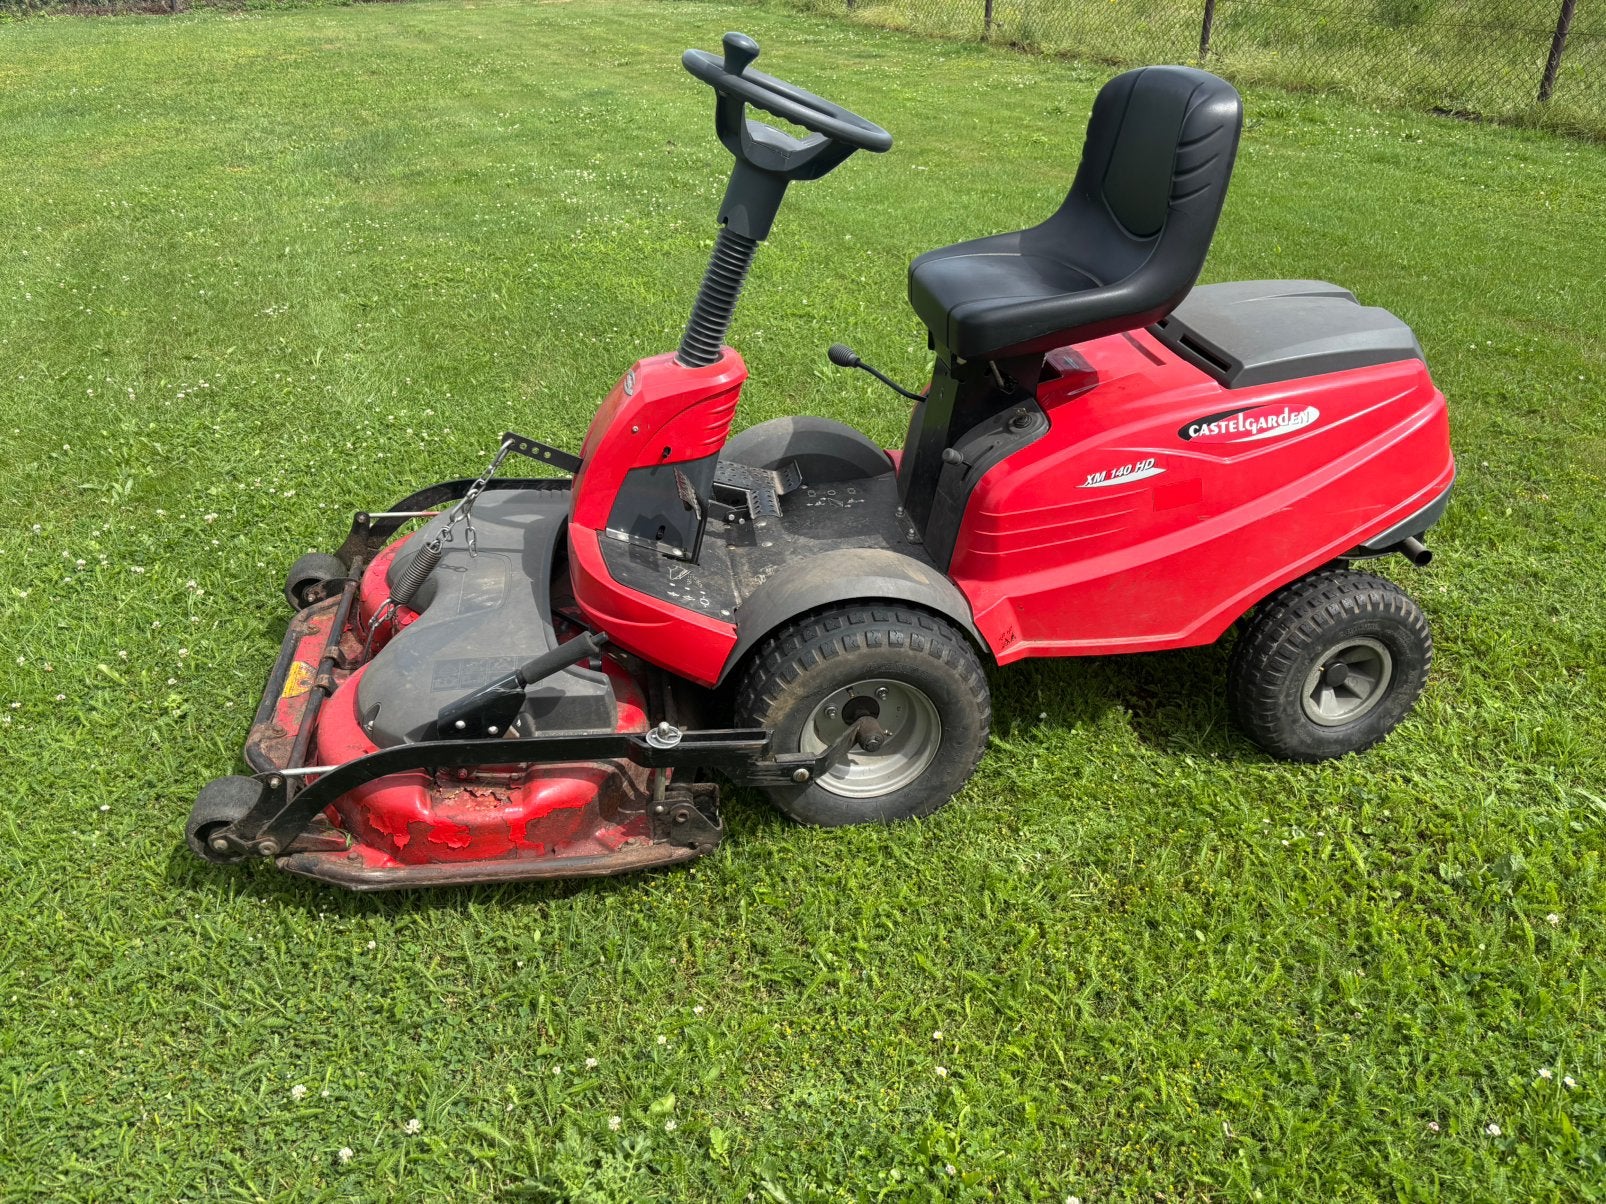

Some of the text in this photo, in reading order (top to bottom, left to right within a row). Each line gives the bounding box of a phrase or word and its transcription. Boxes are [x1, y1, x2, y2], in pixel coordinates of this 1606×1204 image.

[1085, 458, 1155, 486] XM 140 HD
